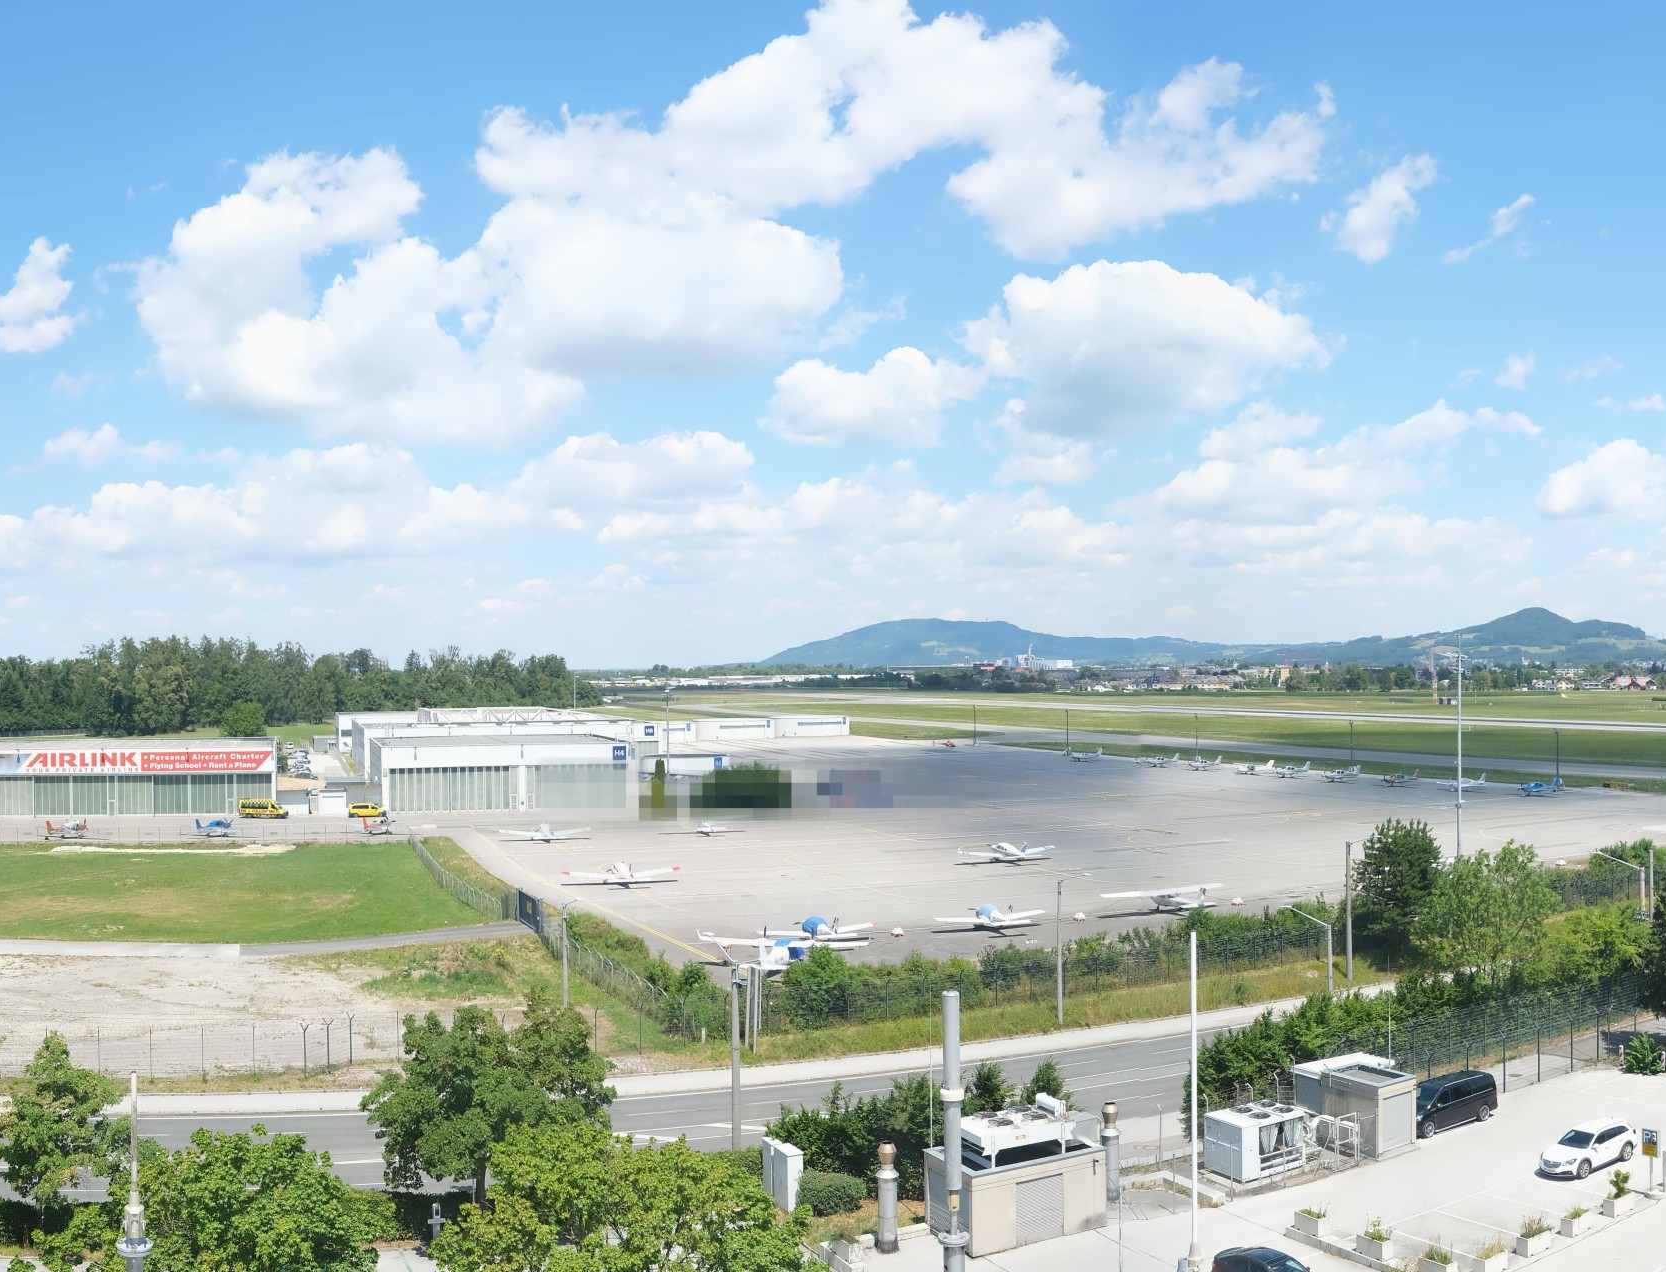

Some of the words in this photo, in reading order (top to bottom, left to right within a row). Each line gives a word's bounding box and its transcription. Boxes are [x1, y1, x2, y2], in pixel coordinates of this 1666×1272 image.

[614, 749, 625, 757] H4
[26, 752, 138, 767] AIRLINK
[150, 762, 173, 770] Flying
